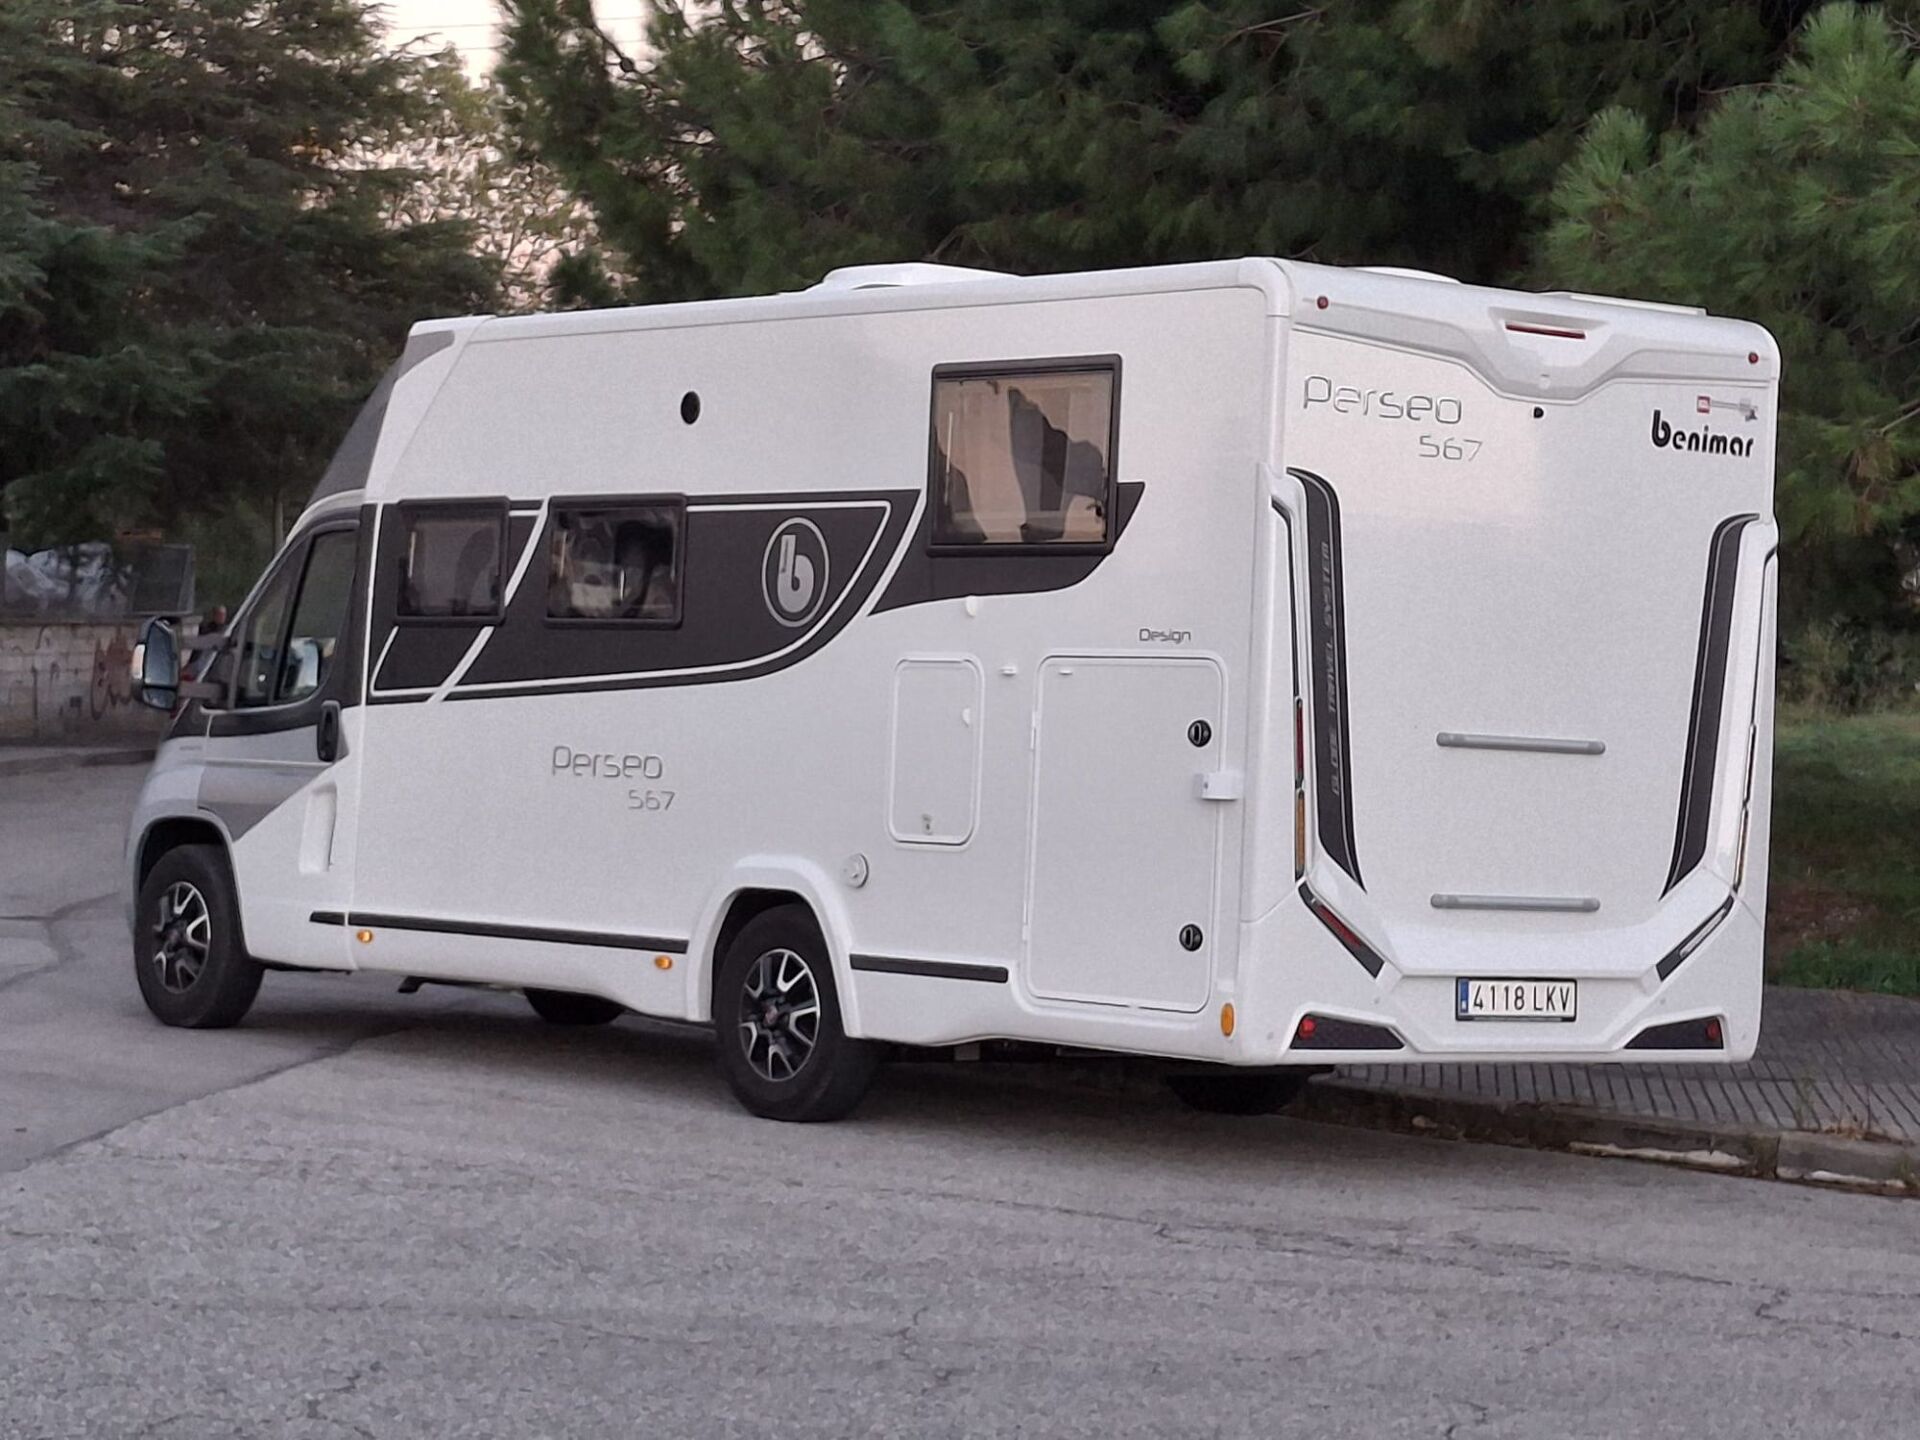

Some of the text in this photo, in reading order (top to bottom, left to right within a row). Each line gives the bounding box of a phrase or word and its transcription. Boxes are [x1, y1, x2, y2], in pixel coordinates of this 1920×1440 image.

[1303, 375, 1462, 425] Perseo
[1418, 434, 1483, 461] 567
[1139, 628, 1191, 645] Design
[552, 745, 663, 779] Perseo
[628, 789, 676, 811] 567
[1473, 985, 1570, 1012] 4118 LKV
